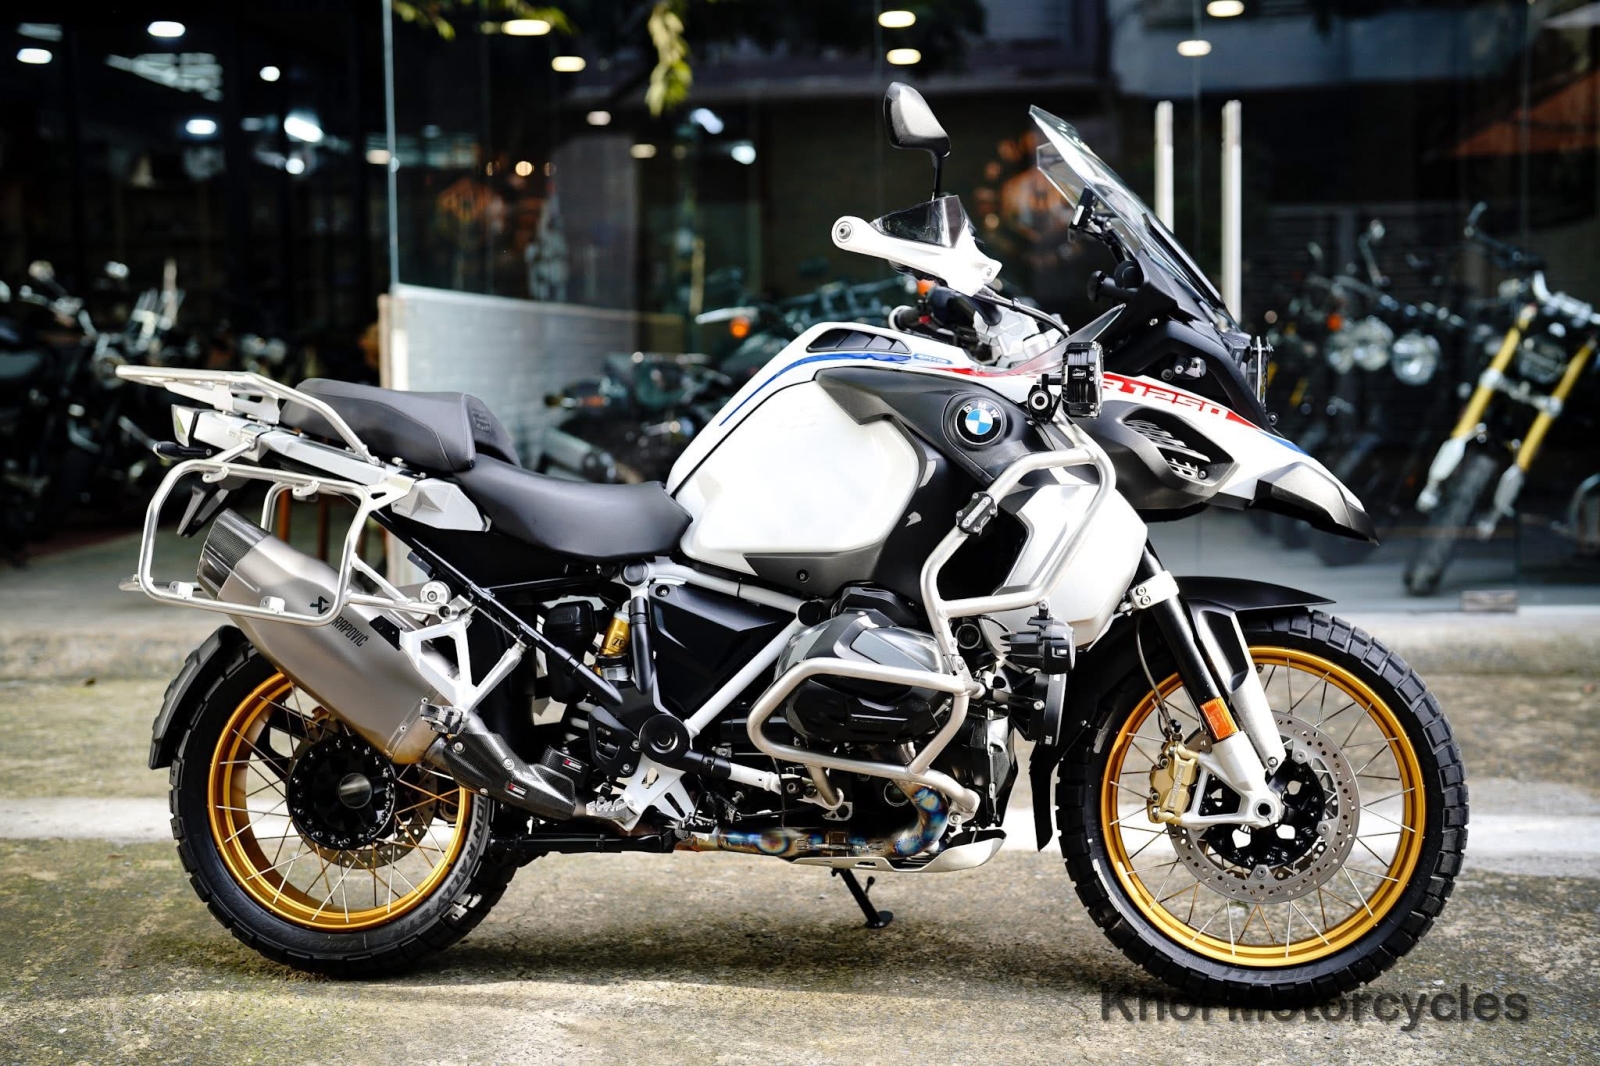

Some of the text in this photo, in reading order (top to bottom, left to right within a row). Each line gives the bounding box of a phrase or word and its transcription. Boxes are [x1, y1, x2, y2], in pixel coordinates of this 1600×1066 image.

[963, 401, 1000, 418] BMW
[1128, 383, 1228, 420] 1250
[331, 616, 370, 647] RAPOVIČ
[436, 842, 477, 911] RALLY
[1222, 963, 1320, 981] PIRELLI
